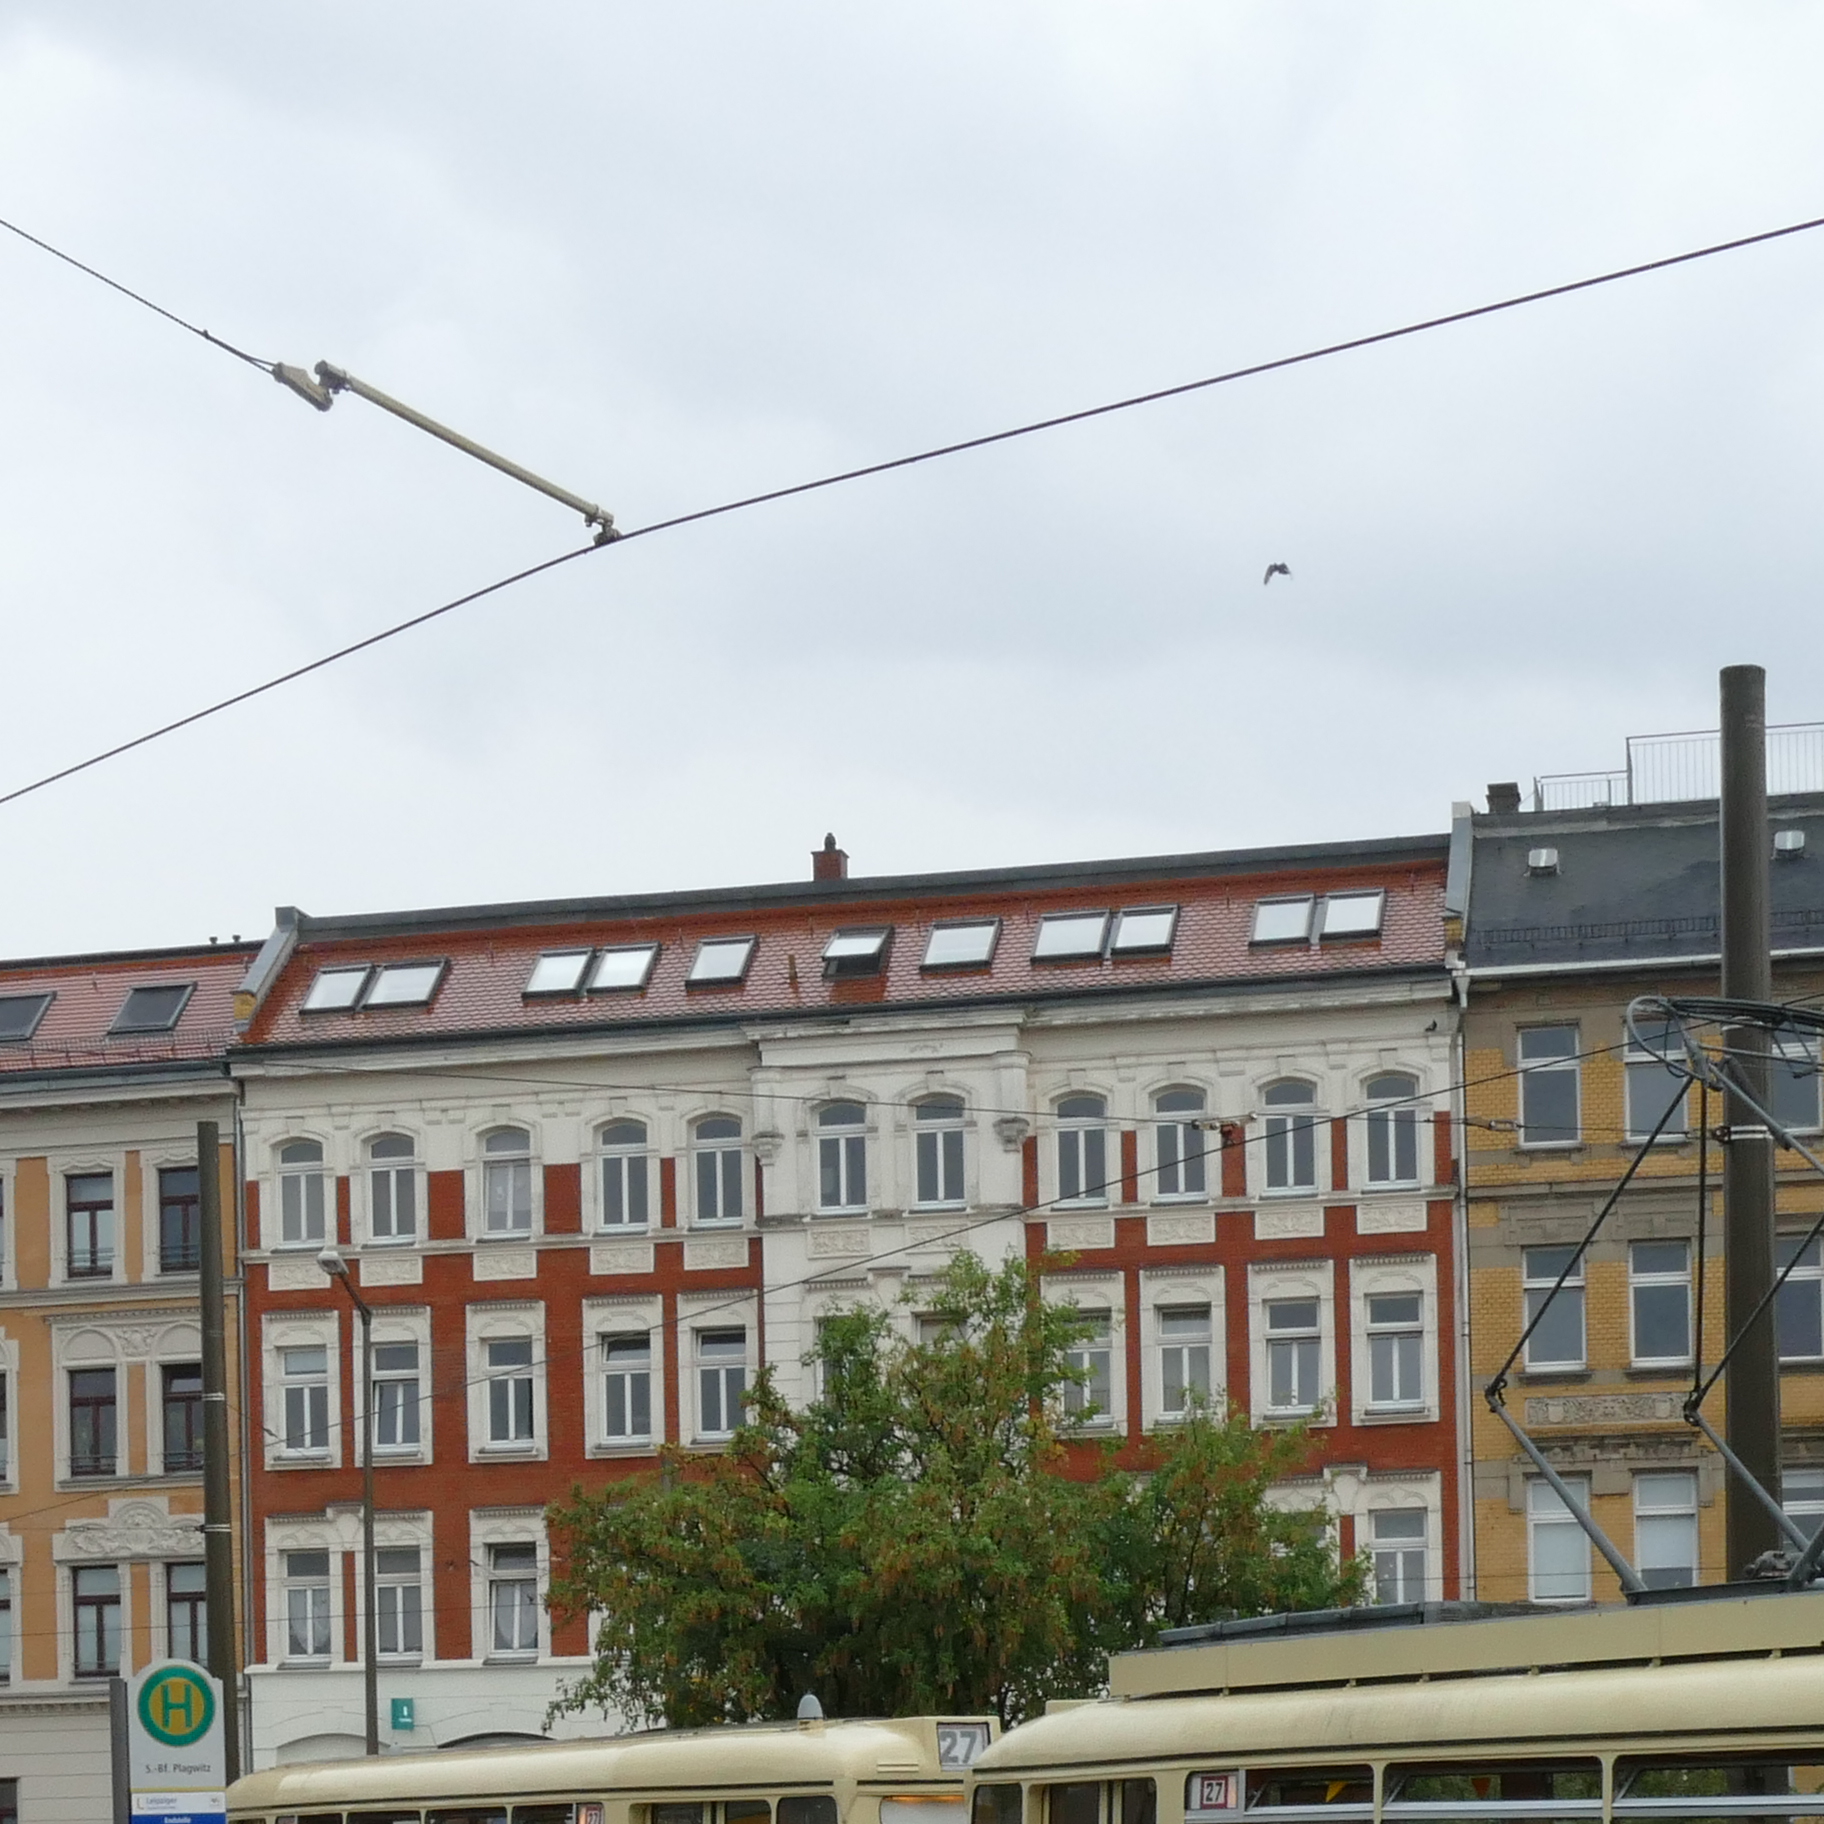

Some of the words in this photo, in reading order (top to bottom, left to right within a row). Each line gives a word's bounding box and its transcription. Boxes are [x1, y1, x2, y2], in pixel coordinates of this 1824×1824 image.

[940, 1730, 977, 1763] 27
[173, 1763, 212, 1775] Plagwitz
[1206, 1782, 1223, 1802] 27
